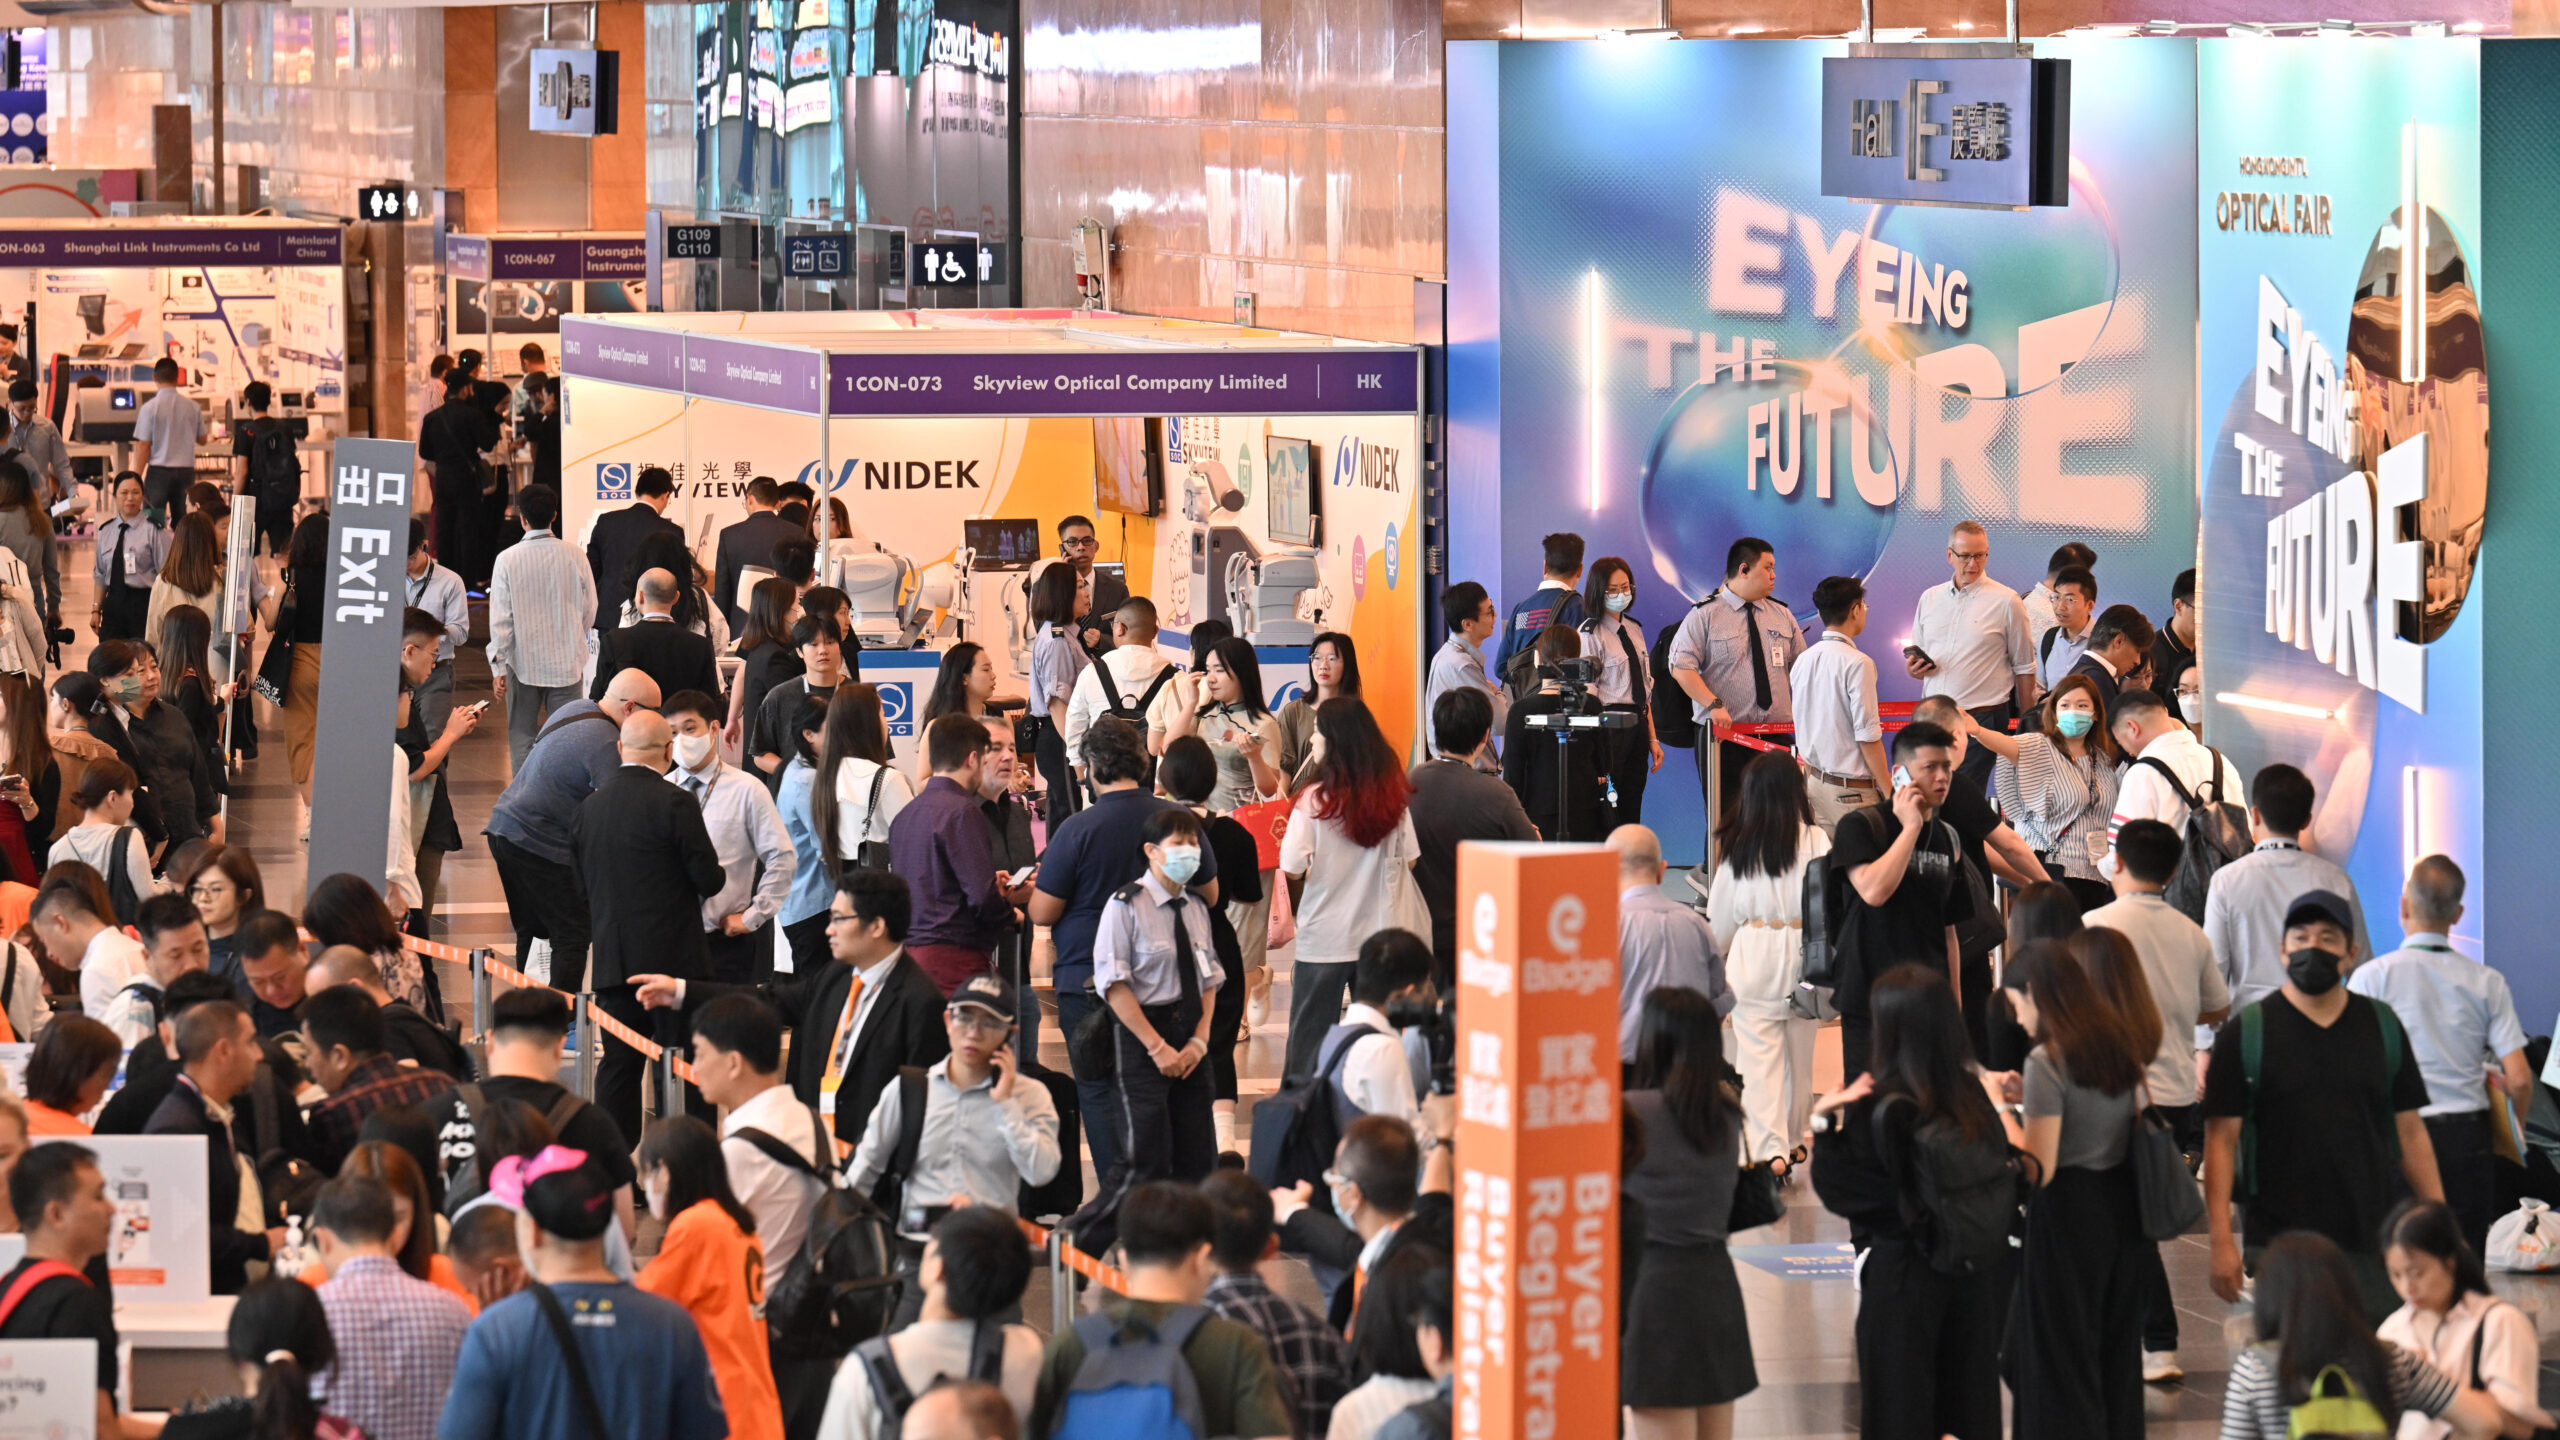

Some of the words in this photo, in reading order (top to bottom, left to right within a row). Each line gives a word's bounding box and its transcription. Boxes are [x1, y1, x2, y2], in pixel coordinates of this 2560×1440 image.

[1850, 99, 1894, 157] Hall
[677, 229, 712, 241] G109
[2216, 191, 2293, 233] OPTICAL
[2294, 193, 2333, 236] FAIR
[64, 241, 121, 255] Shanghai
[123, 241, 149, 254] Link
[152, 241, 221, 254] Instruments
[224, 241, 239, 253] Co
[241, 241, 261, 253] Ltd
[286, 235, 337, 247] Mainland
[296, 247, 327, 259] China
[504, 253, 556, 265] 1CON-067
[677, 243, 712, 255] G110
[1704, 186, 1969, 330] EYEING
[726, 361, 740, 382] Skyview
[753, 365, 768, 387] Company
[768, 367, 782, 385] Limited
[1610, 318, 1778, 391] THE
[2254, 273, 2363, 465] EYEING
[845, 375, 943, 392] 1CON-073
[973, 374, 1049, 394] Skyview
[1054, 374, 1121, 394] Optical
[1126, 374, 1214, 394] Company
[1219, 373, 1288, 390] Limited
[1356, 373, 1383, 389] HK
[1746, 298, 2155, 536] FUTURE
[336, 465, 406, 507] 出口
[864, 460, 981, 490] NIDEK
[1360, 442, 1400, 494] NIDEK
[2233, 431, 2284, 498] THE
[600, 491, 628, 500] SOC
[335, 526, 392, 625] Exit
[2264, 431, 2429, 716] FUTURE
[1521, 956, 1615, 996] Badge
[1482, 1174, 1512, 1368] Buyer
[1563, 1170, 1613, 1362] Buyer
[1456, 1167, 1485, 1440] Registra
[1516, 1175, 1568, 1440] Registra
